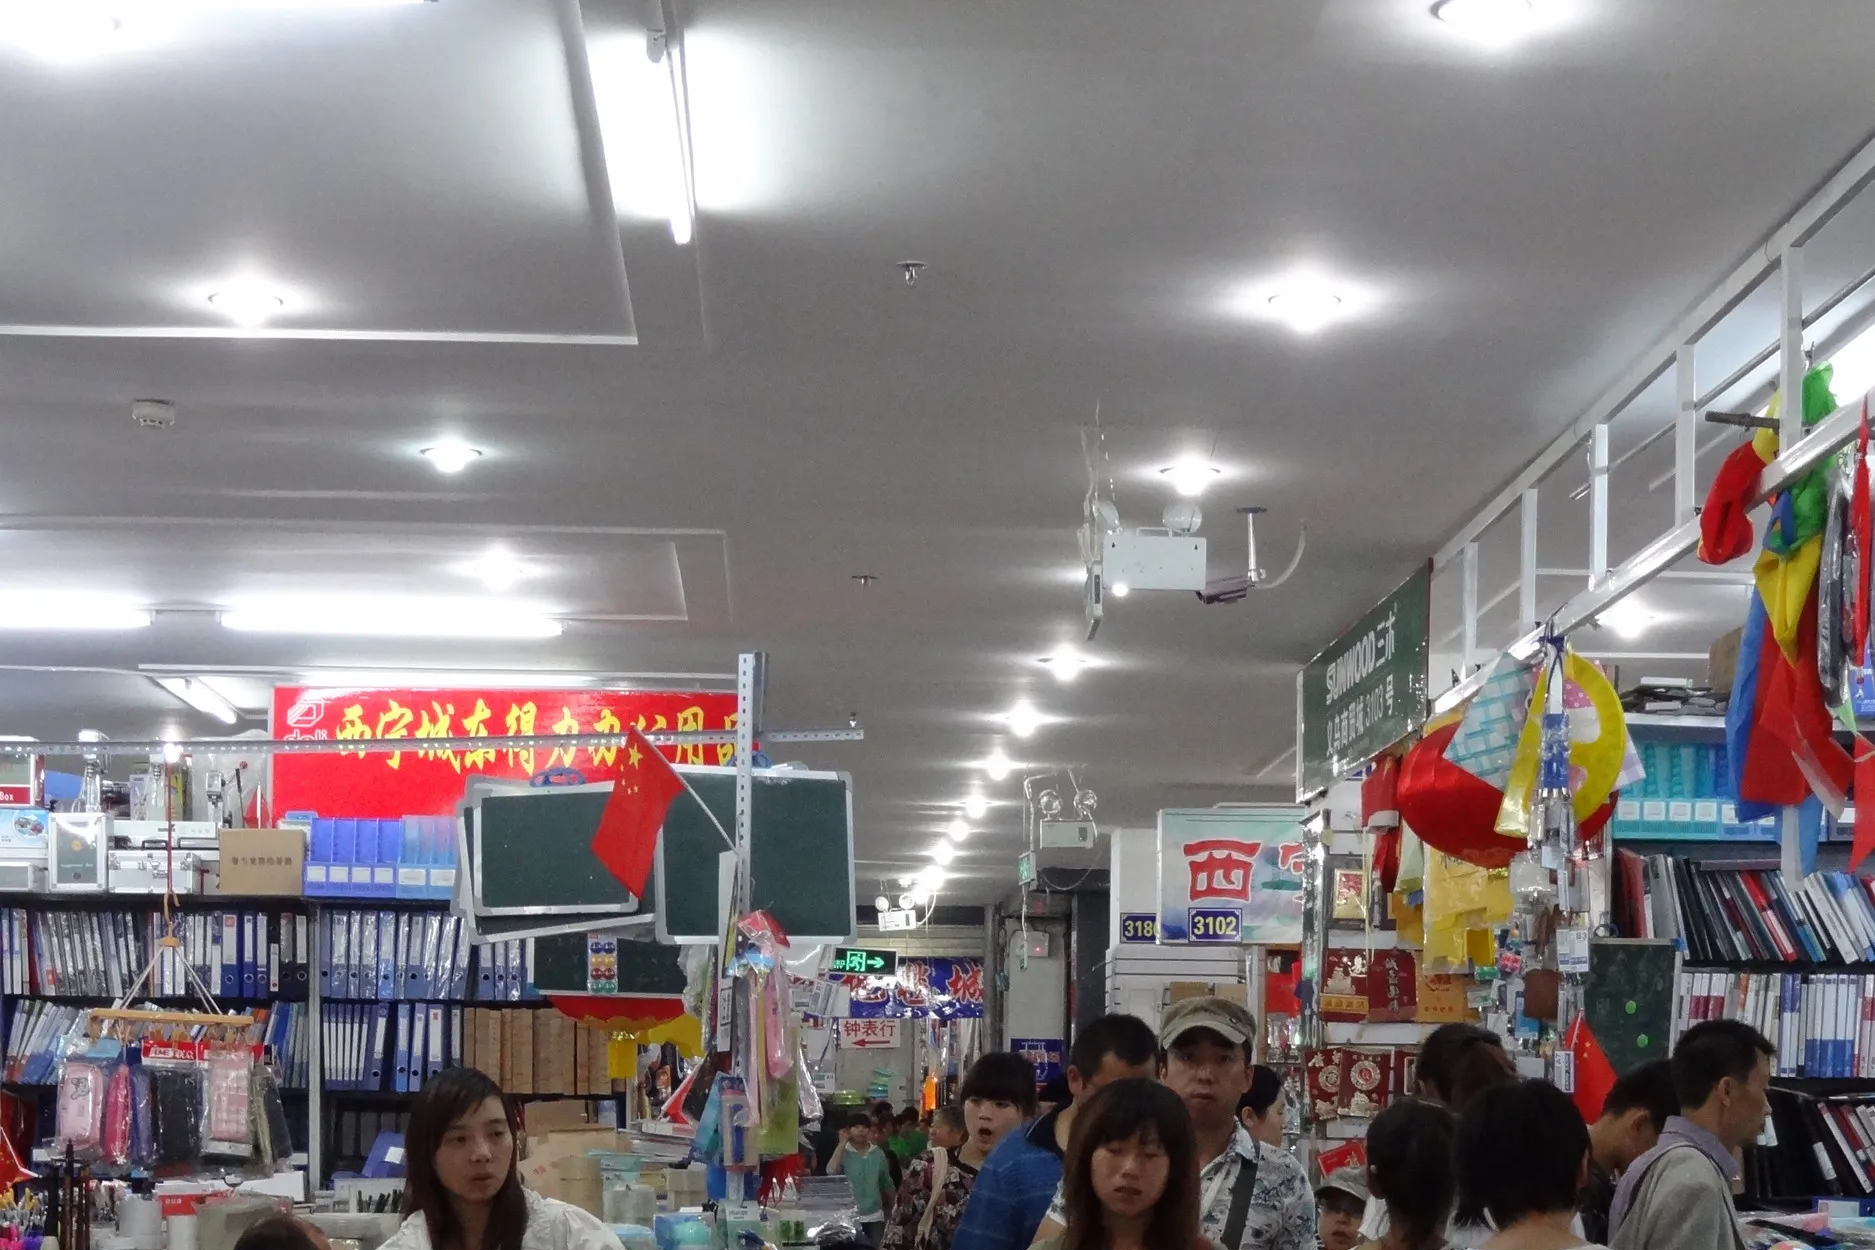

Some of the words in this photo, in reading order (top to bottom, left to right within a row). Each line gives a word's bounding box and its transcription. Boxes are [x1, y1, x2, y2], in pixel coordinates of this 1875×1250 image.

[1326, 630, 1375, 705] SUNWOOD
[1193, 916, 1237, 935] 3102
[843, 1020, 896, 1037] 钟表行
